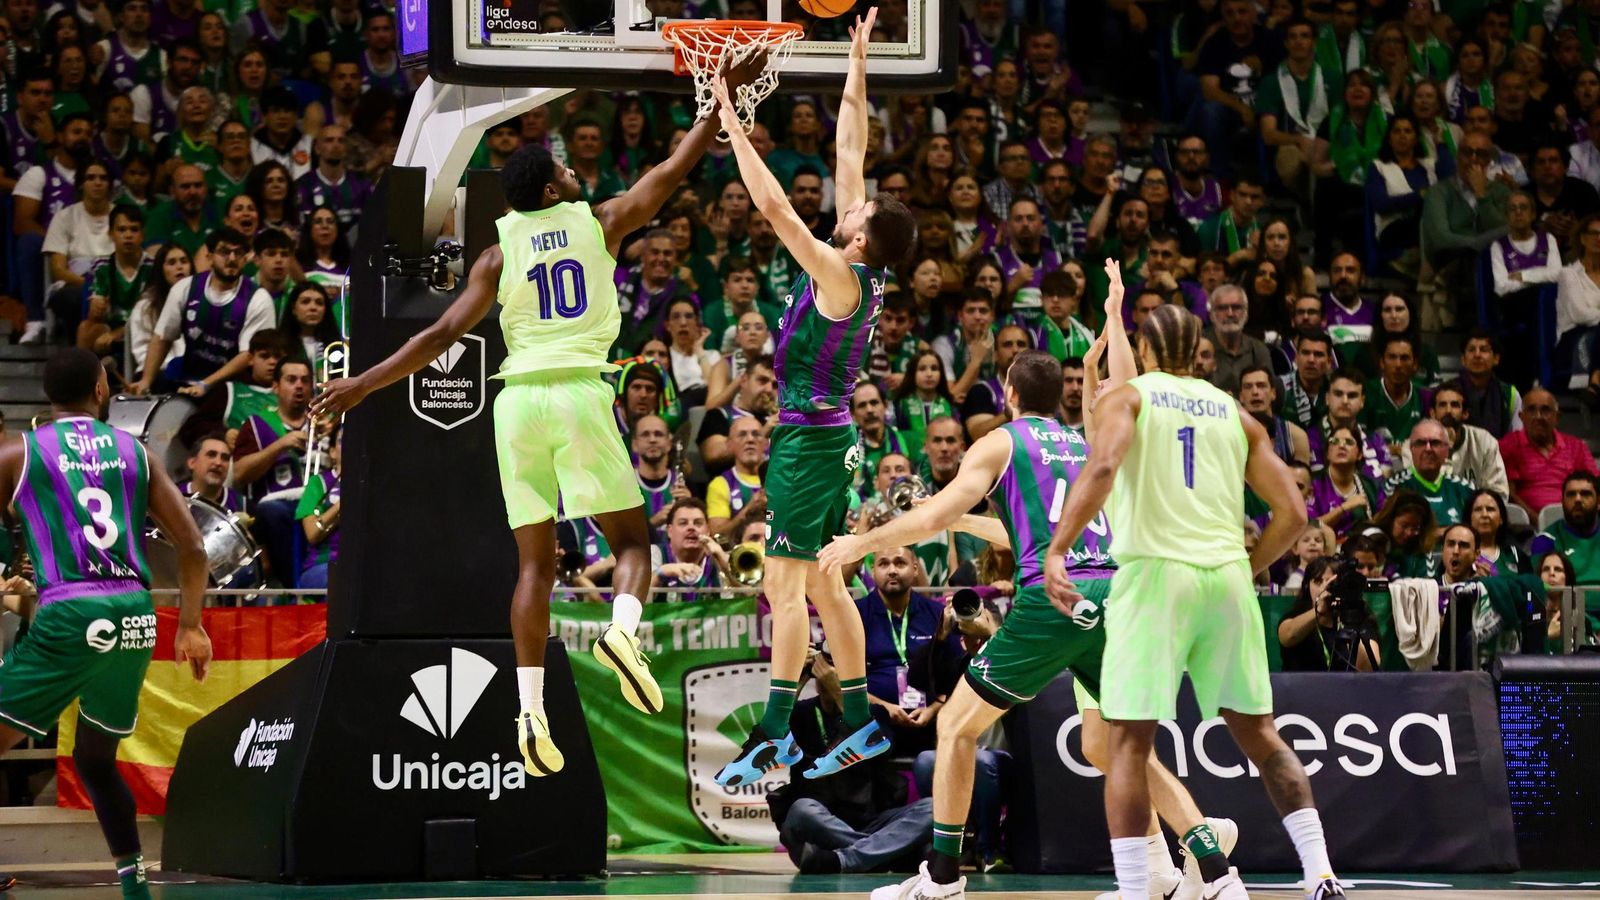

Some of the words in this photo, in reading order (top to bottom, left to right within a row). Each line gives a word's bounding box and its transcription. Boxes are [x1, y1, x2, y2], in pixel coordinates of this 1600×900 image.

[486, 5, 509, 18] liga
[486, 18, 537, 30] endesa
[531, 230, 568, 253] METU
[527, 259, 588, 319] 10
[422, 378, 473, 388] Fundación
[422, 400, 473, 408] Baloncesto
[430, 390, 466, 401] Unicaja
[1150, 391, 1228, 420] ANDERSON
[65, 432, 113, 455] Ejim
[1177, 426, 1195, 490] 1
[77, 487, 119, 550] 3
[121, 614, 157, 629] COSTA
[121, 629, 143, 640] DEL
[254, 717, 294, 743] Fundación
[248, 743, 278, 773] Unicaja
[372, 752, 525, 800] Unicaja
